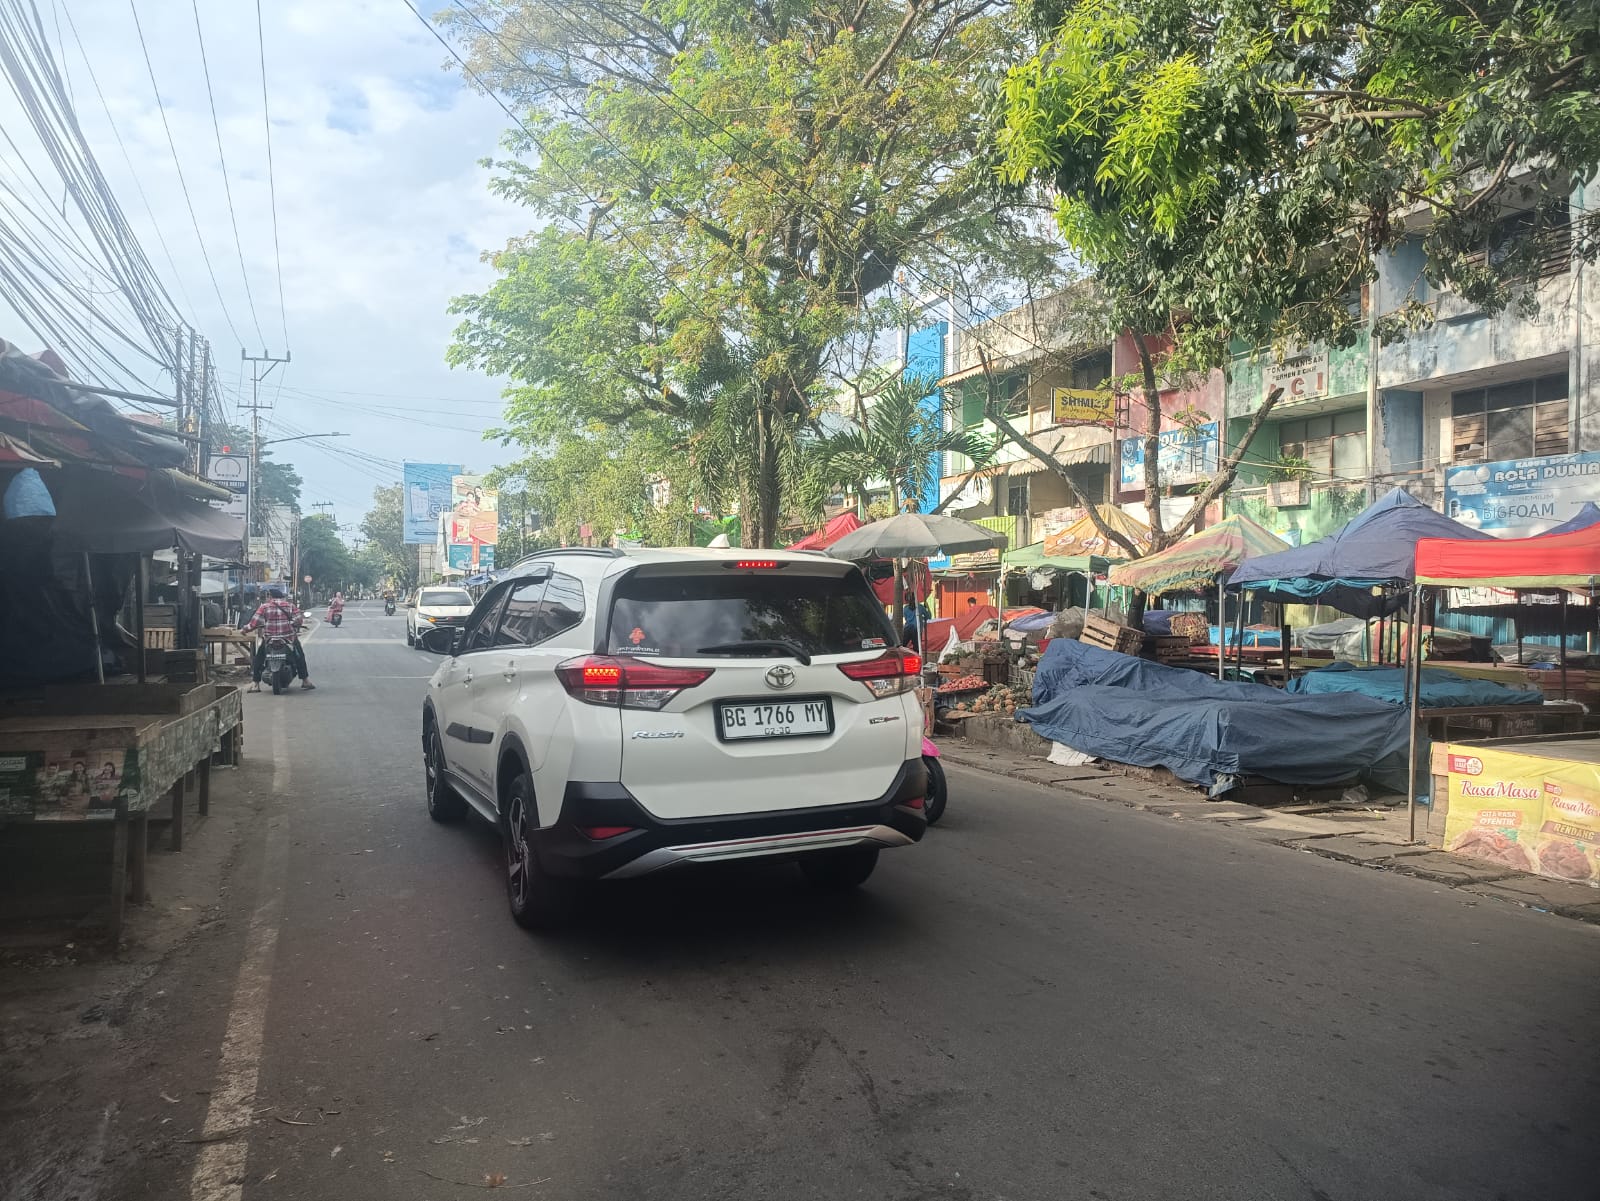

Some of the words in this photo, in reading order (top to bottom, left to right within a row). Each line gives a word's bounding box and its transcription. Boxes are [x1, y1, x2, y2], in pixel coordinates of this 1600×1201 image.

[1494, 468, 1538, 483] BOLA
[1543, 462, 1600, 479] DUNIA
[725, 708, 747, 727] BG
[754, 705, 795, 726] 1766
[804, 703, 825, 723] MY
[1553, 823, 1596, 841] RENDANG
